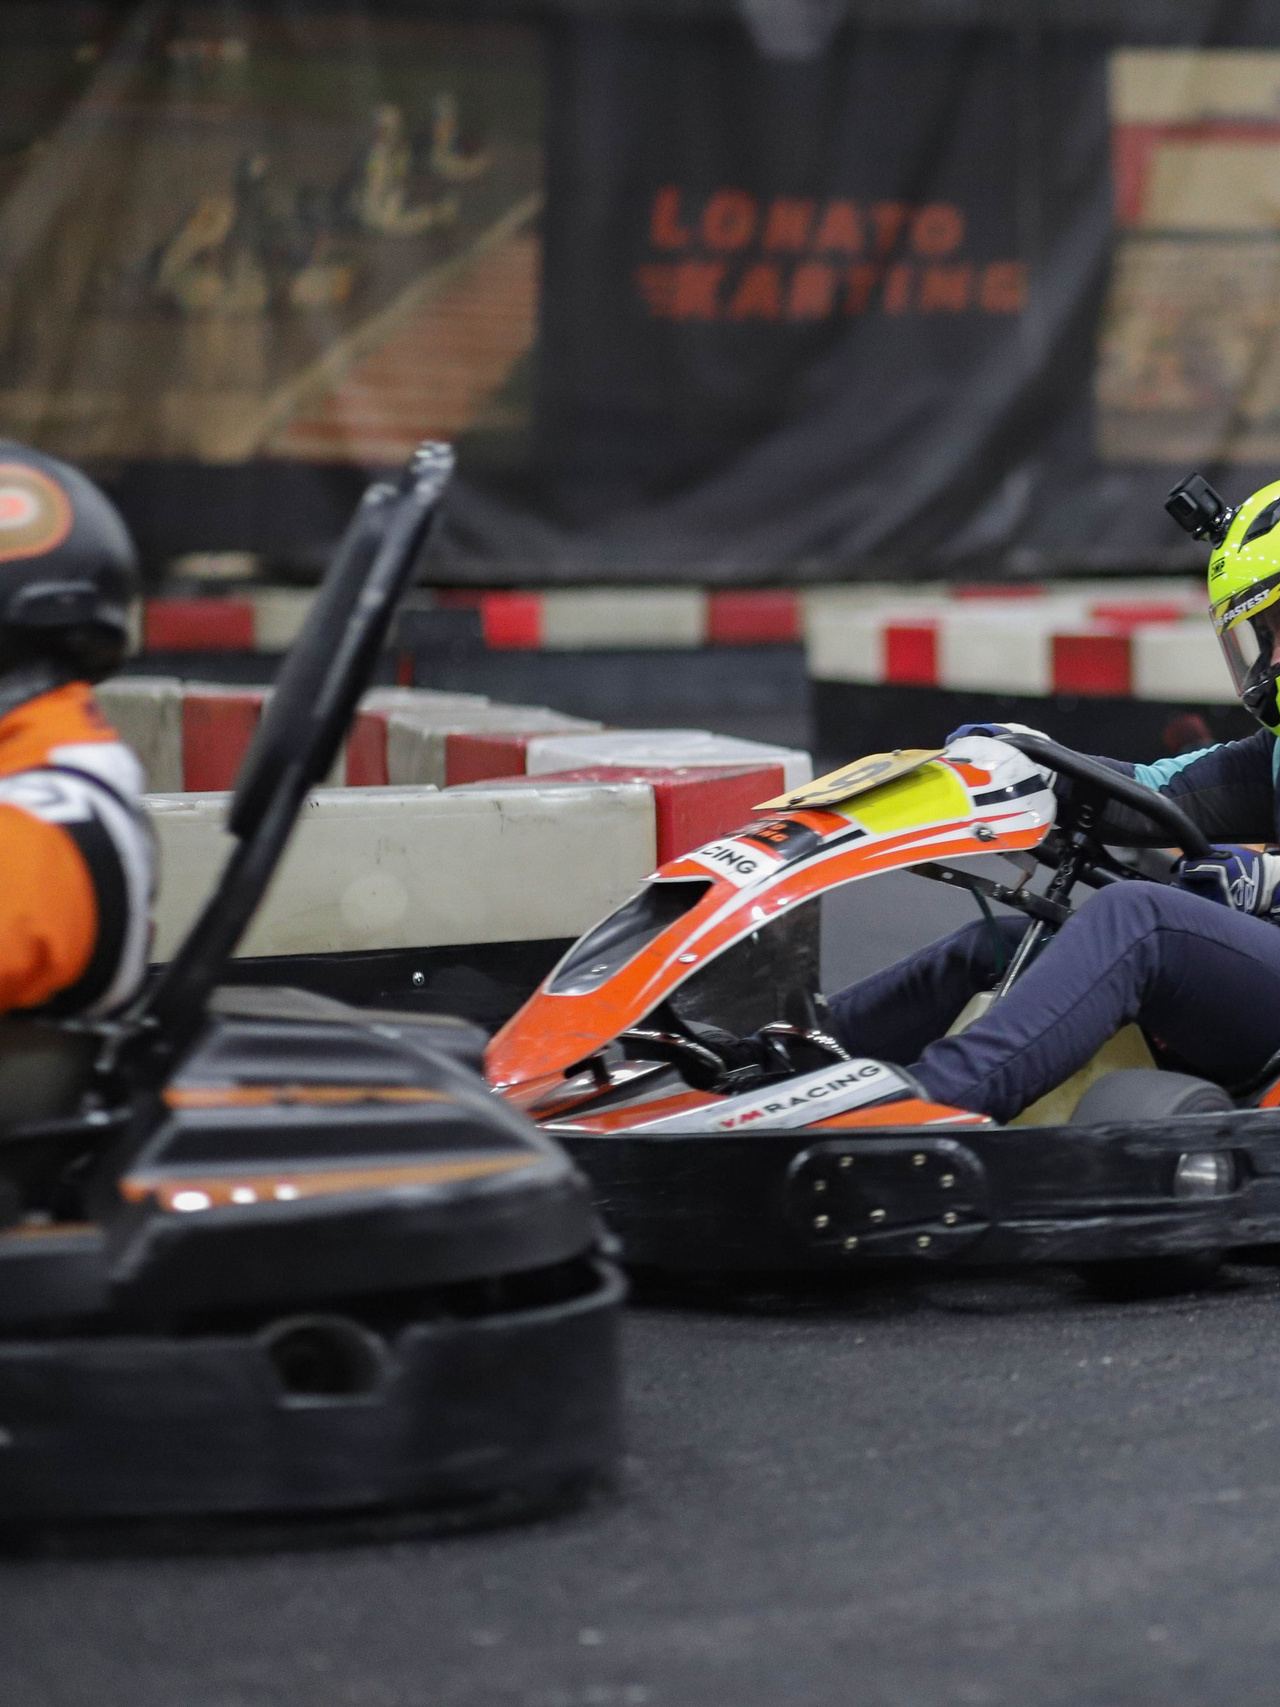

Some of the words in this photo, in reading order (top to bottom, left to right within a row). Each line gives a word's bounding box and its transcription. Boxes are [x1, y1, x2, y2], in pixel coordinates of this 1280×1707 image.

[650, 184, 966, 255] LONATO
[635, 260, 1030, 323] KARTING
[1223, 589, 1270, 623] FASTEST
